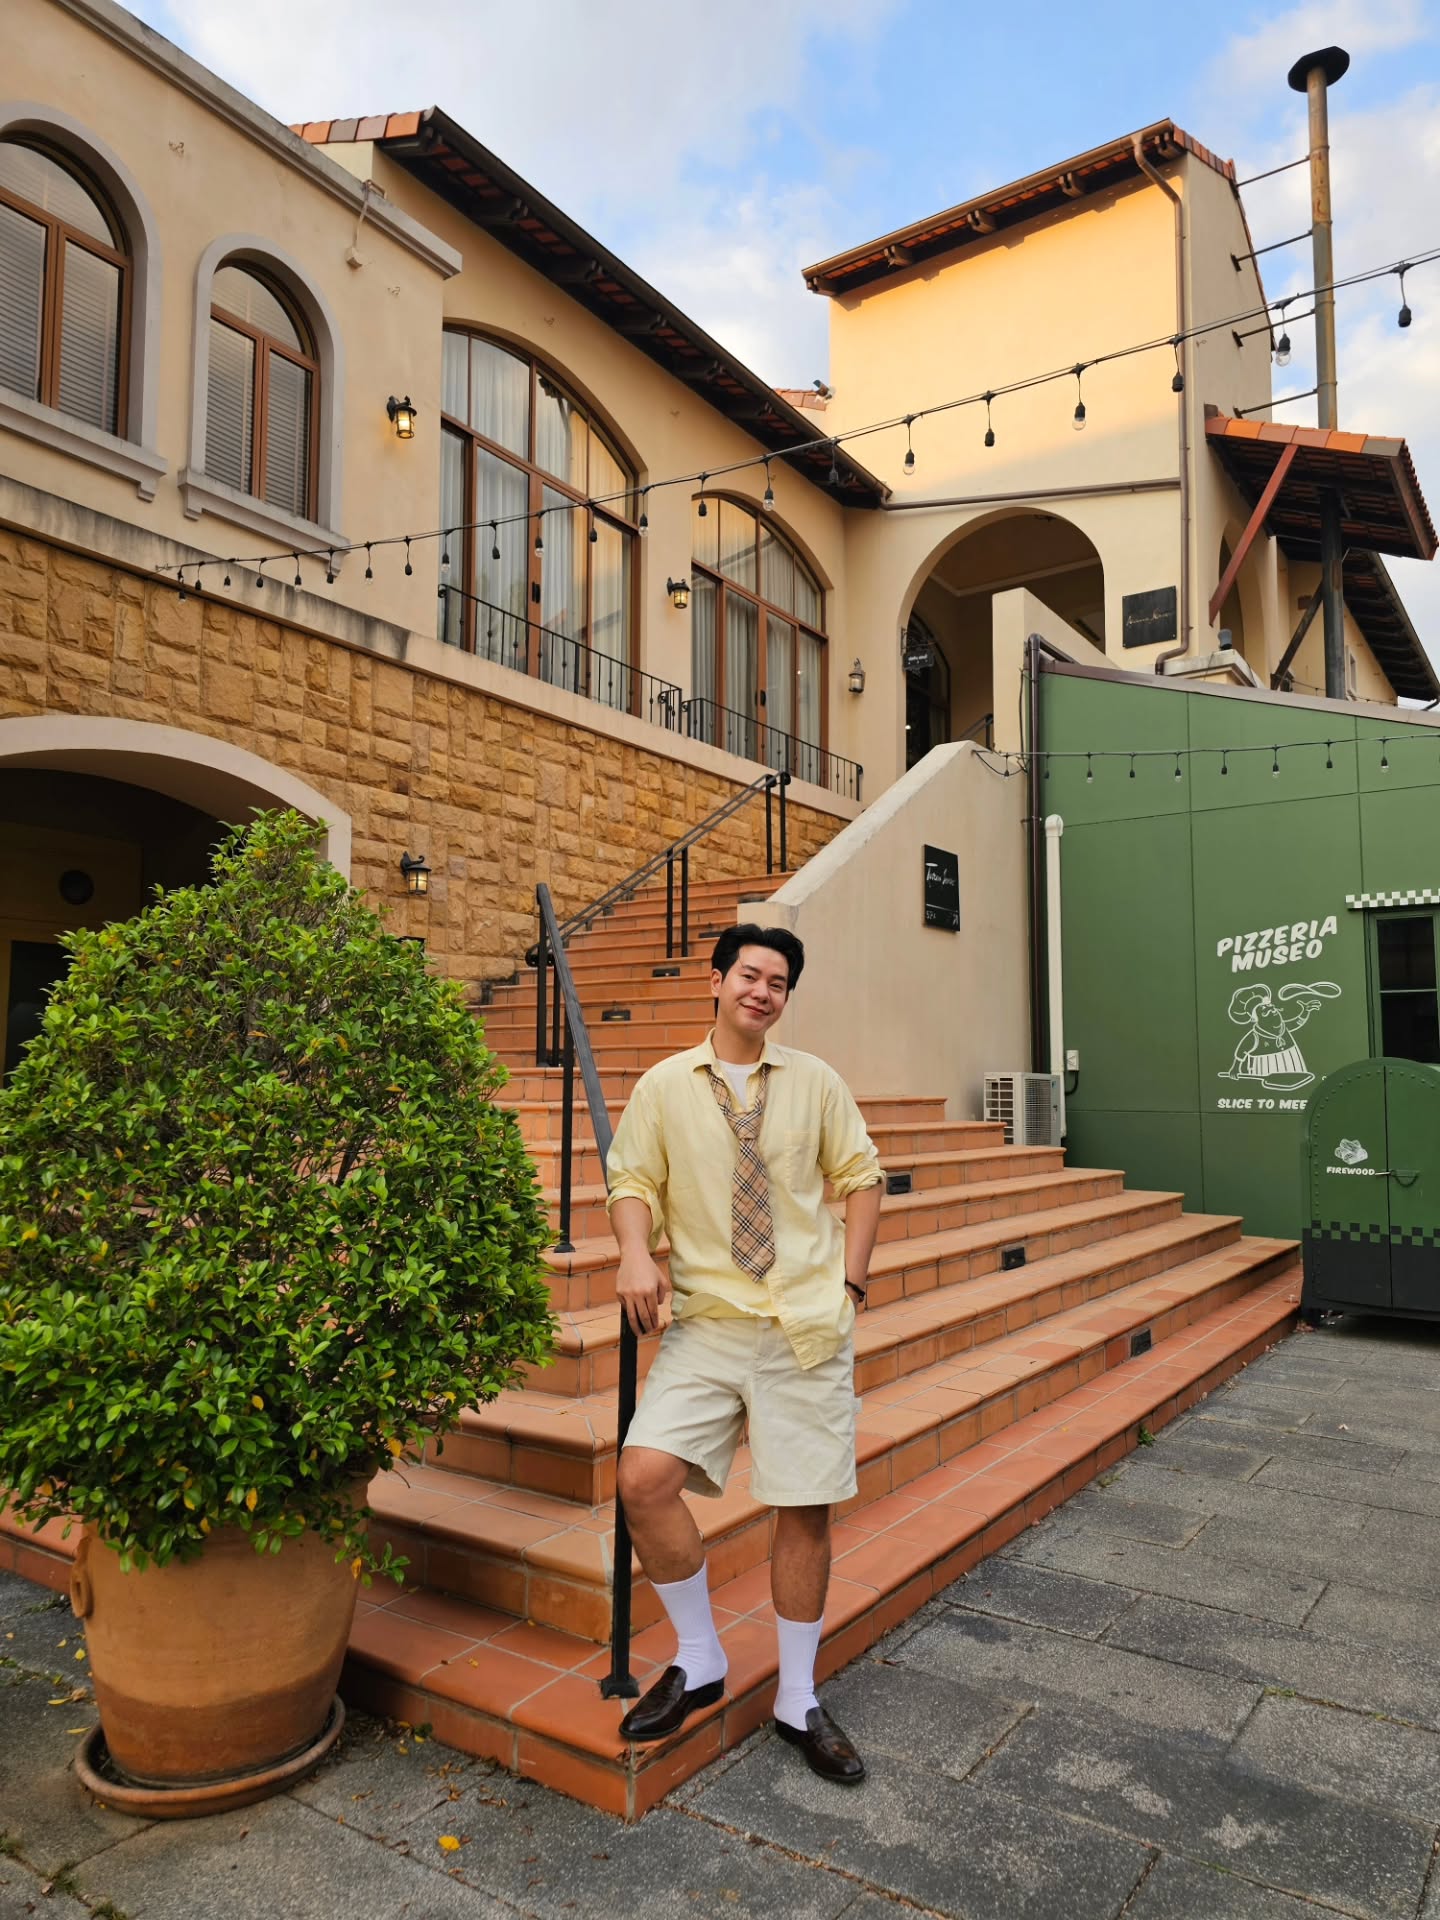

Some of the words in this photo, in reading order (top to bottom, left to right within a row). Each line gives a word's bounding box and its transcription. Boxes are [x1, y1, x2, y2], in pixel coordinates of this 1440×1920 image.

[1217, 916, 1338, 957] PIZZERIA
[1231, 939, 1323, 973] MUSEO
[1217, 1098, 1253, 1109] SLICE
[1257, 1098, 1275, 1109] TO
[1279, 1099, 1308, 1110] MEE
[1326, 1166, 1376, 1176] FIREWOOD
